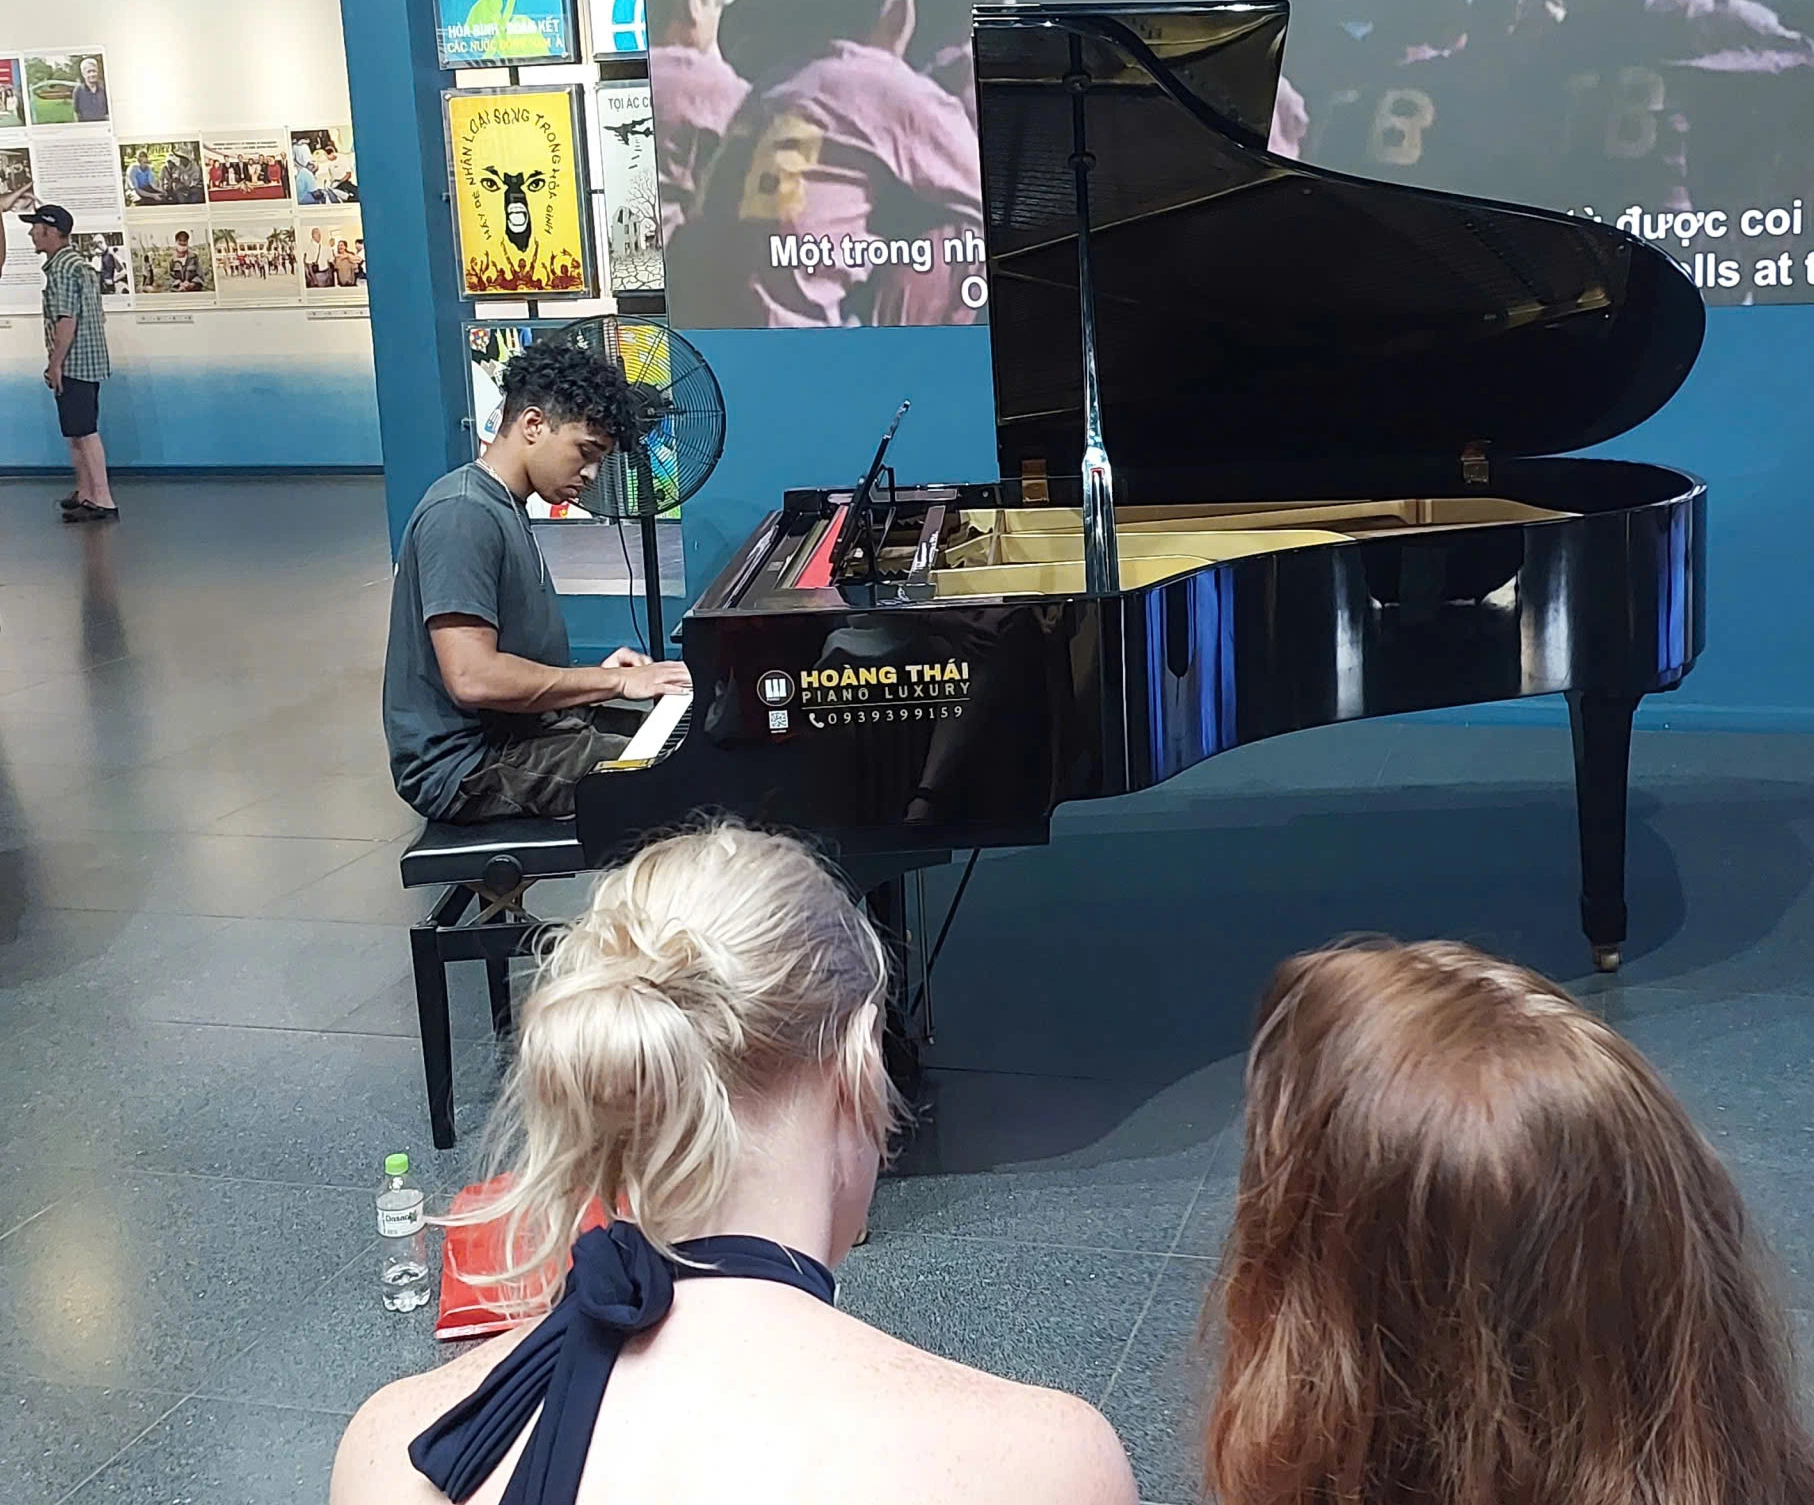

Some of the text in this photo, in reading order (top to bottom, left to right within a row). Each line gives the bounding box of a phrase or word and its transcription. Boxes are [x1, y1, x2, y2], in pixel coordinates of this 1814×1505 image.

[1740, 198, 1802, 237] coi
[769, 234, 833, 274] Một
[841, 234, 933, 273] trong
[1754, 251, 1793, 286] at
[801, 658, 969, 688] HOÀNG THÁI
[885, 681, 970, 699] LUXURY
[828, 706, 962, 724] 0939399159
